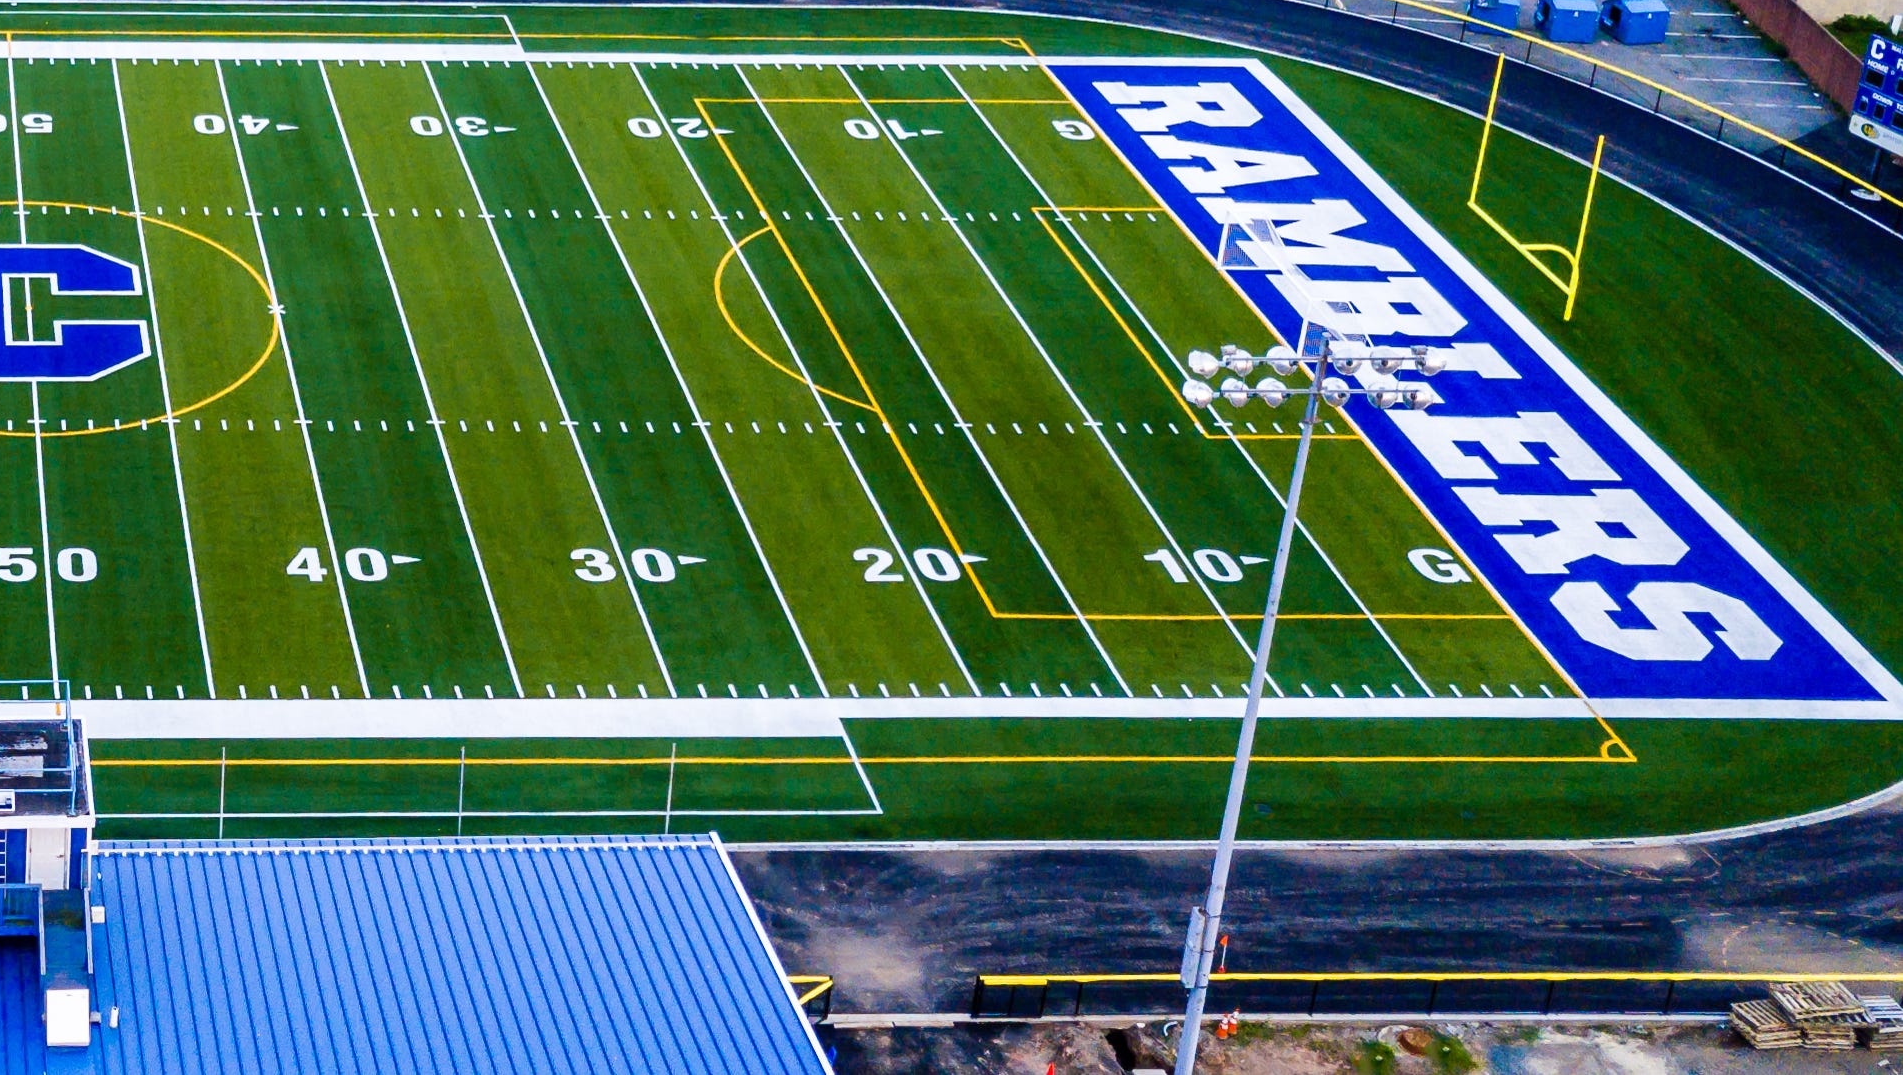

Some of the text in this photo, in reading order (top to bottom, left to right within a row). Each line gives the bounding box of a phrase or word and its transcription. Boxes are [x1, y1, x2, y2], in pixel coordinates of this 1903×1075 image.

[1871, 39, 1885, 59] C
[1867, 59, 1889, 73] HOME
[1873, 93, 1893, 106] DOWN
[193, 113, 271, 135] 40
[409, 115, 490, 137] 30
[627, 117, 709, 139] 20
[843, 118, 919, 140] 10
[1051, 119, 1096, 141] G
[1091, 80, 1784, 661] RAMBLERS
[285, 547, 388, 582] 40
[570, 547, 676, 583] 30
[852, 547, 961, 583] 20
[1143, 548, 1244, 583] 10
[1407, 548, 1473, 584] G
